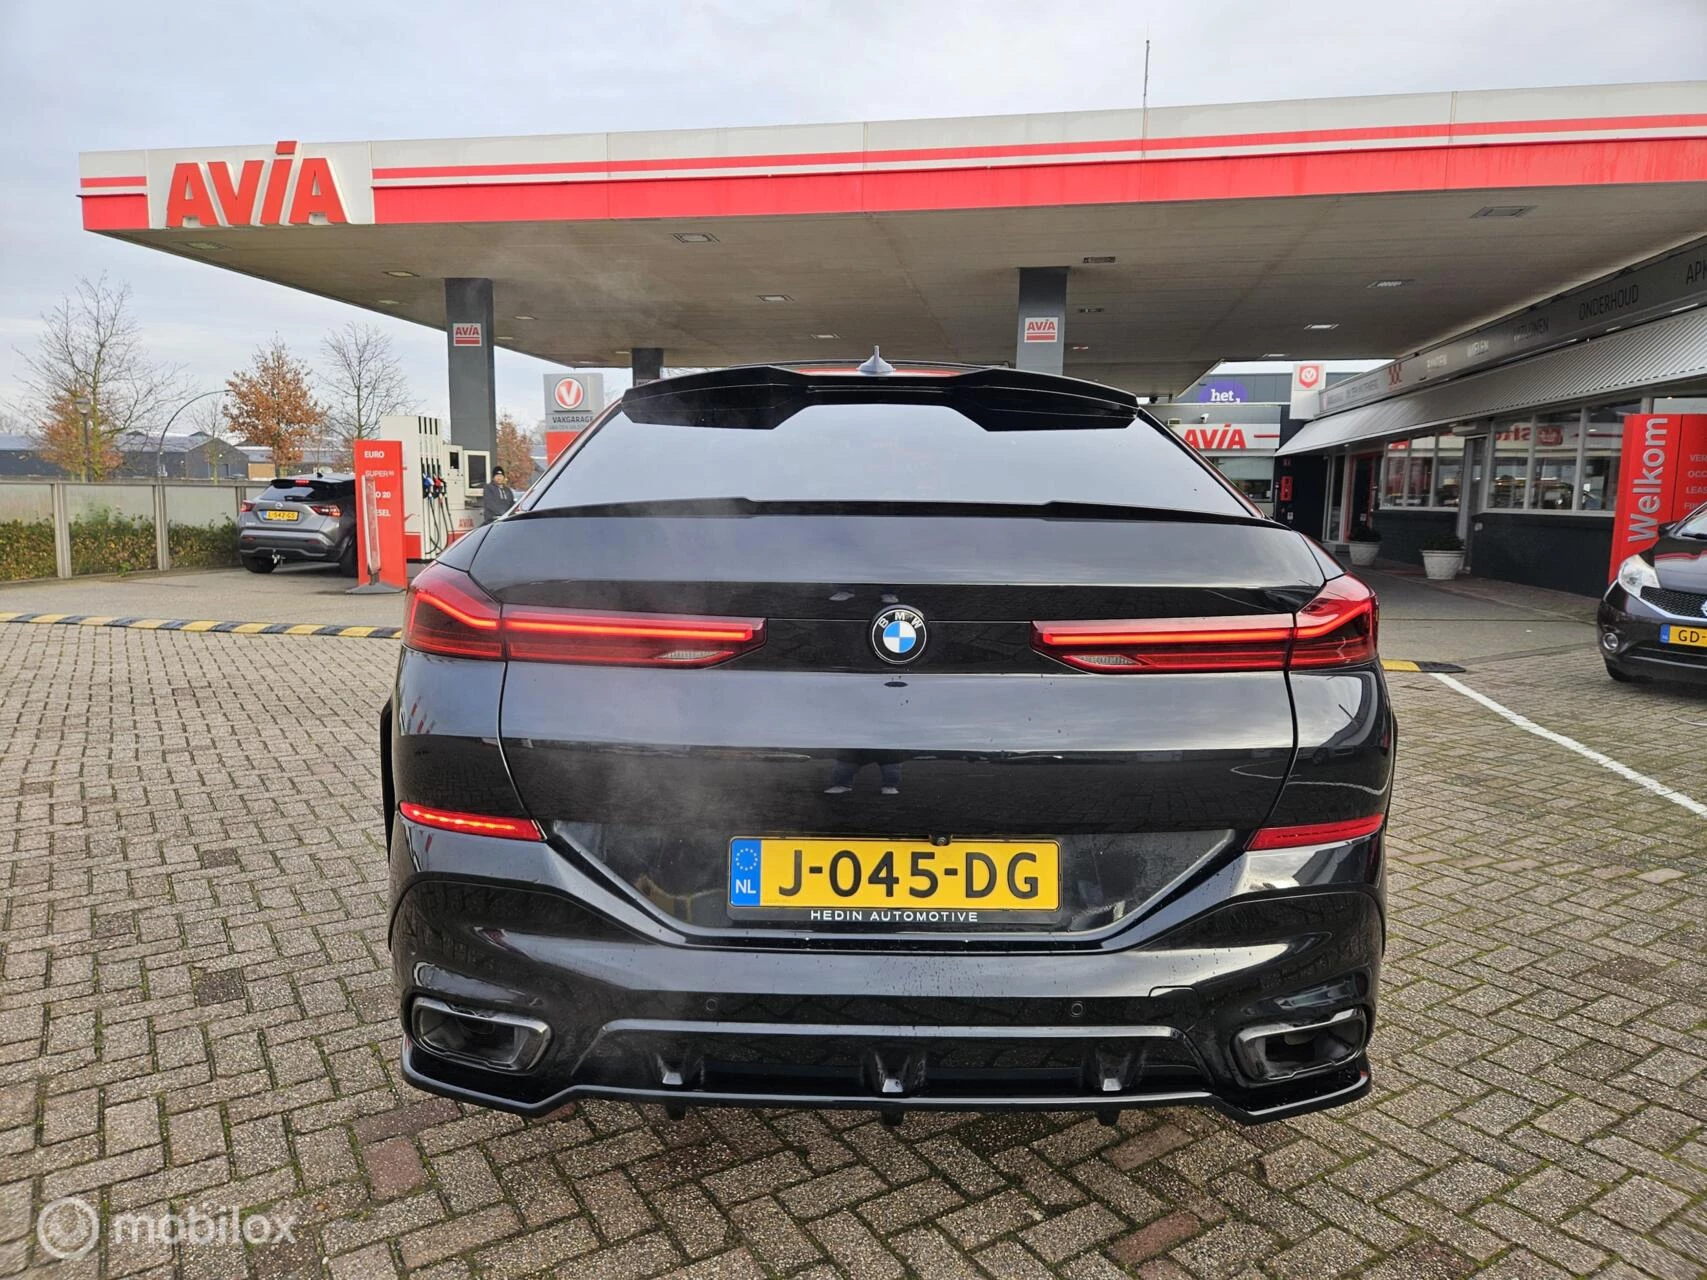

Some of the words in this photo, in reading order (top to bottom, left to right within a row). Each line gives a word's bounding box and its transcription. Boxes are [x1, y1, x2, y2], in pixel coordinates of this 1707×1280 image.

[166, 140, 350, 226] AVIA
[1579, 284, 1639, 321] ONDERHOUD
[455, 325, 480, 336] AVIA
[1027, 318, 1056, 331] AVIA
[1210, 389, 1234, 402] het
[1184, 424, 1246, 449] AVIA
[364, 450, 385, 459] EURO
[1628, 418, 1668, 542] Welkom
[879, 611, 922, 629] BMW
[735, 878, 757, 894] NL
[778, 850, 1039, 899] J-045-DG
[810, 910, 863, 921] HEDIN
[870, 911, 978, 922] AUTOMOTIVE
